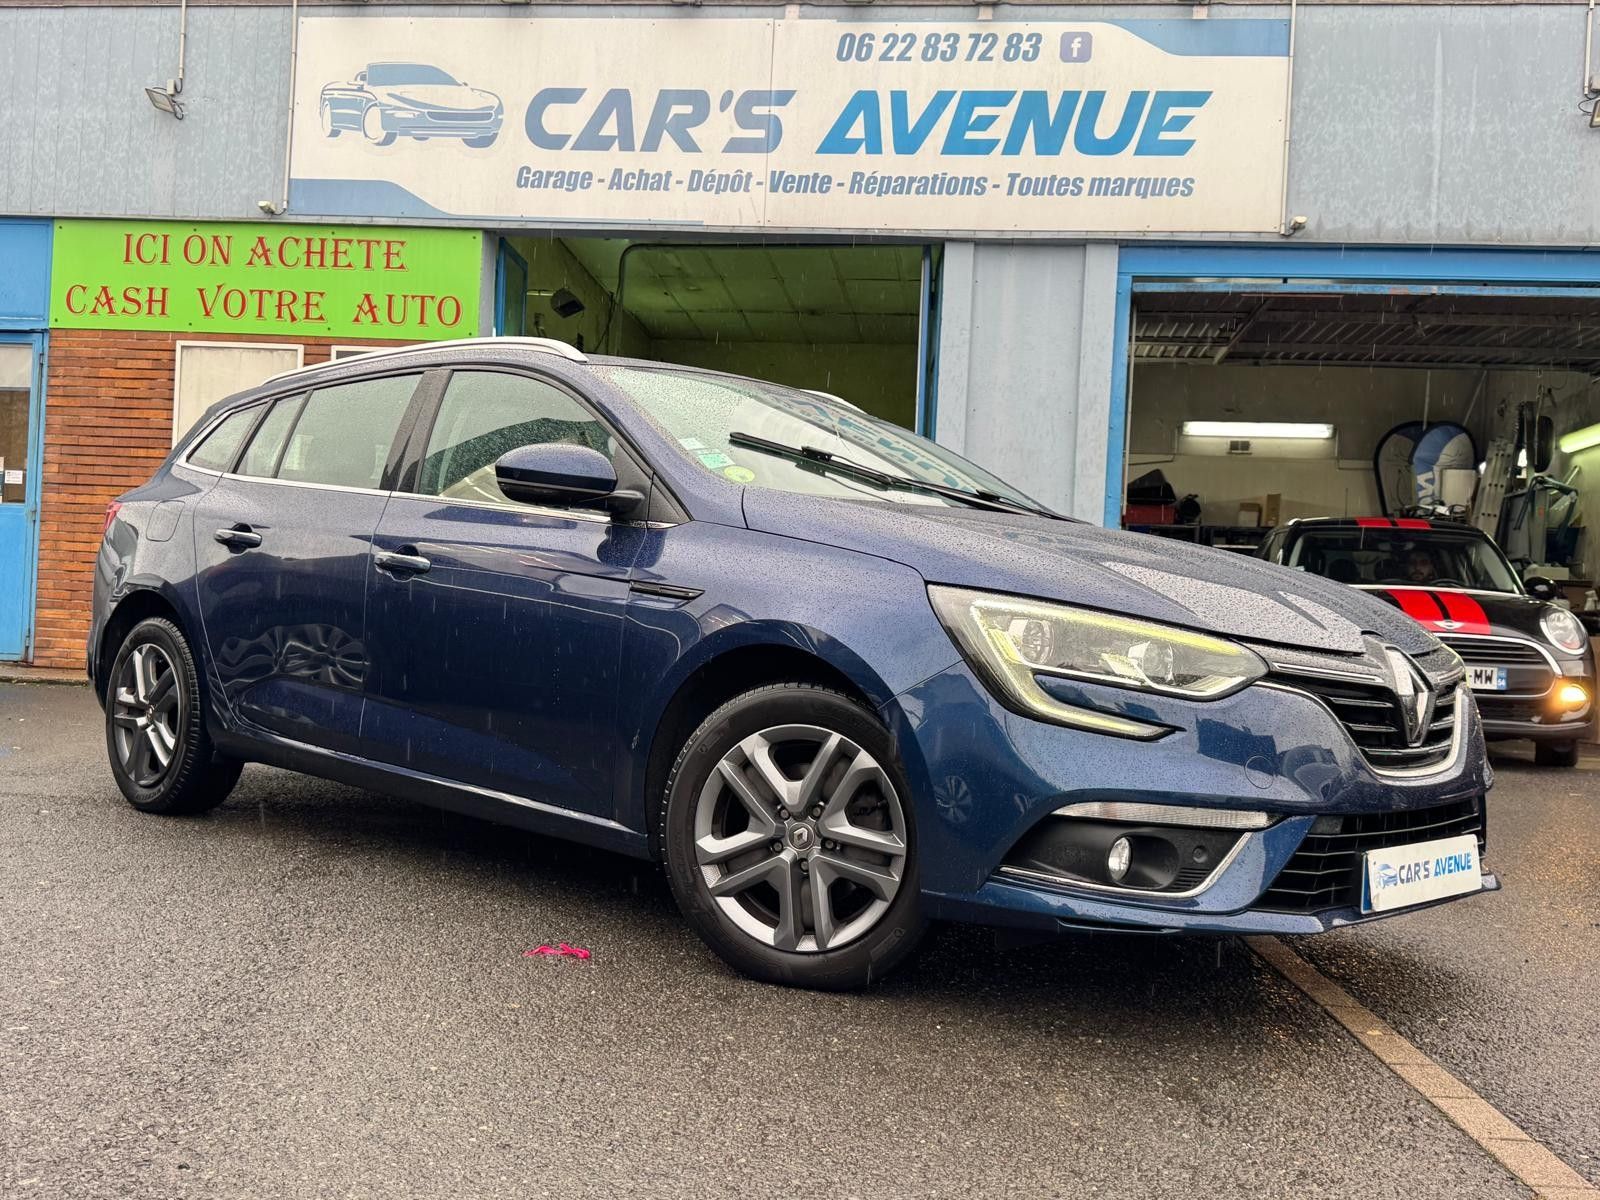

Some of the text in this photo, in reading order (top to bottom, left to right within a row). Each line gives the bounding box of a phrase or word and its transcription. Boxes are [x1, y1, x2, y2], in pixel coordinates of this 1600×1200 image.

[836, 32, 1044, 64] 06 22 83 72 83
[524, 88, 1214, 158] CAR'S AVENUE
[516, 165, 593, 193] Garage
[608, 167, 673, 193] Achat
[687, 168, 753, 196] Dépôt
[768, 169, 833, 195] Vente
[848, 169, 990, 198] Réparations
[1006, 171, 1085, 197] Toutes
[1088, 175, 1196, 199] marques
[123, 232, 408, 272] ICI ON ACHETE
[65, 283, 464, 328] CASH VOTRE AUTO
[1399, 851, 1472, 884] CAR'S AVENUE
